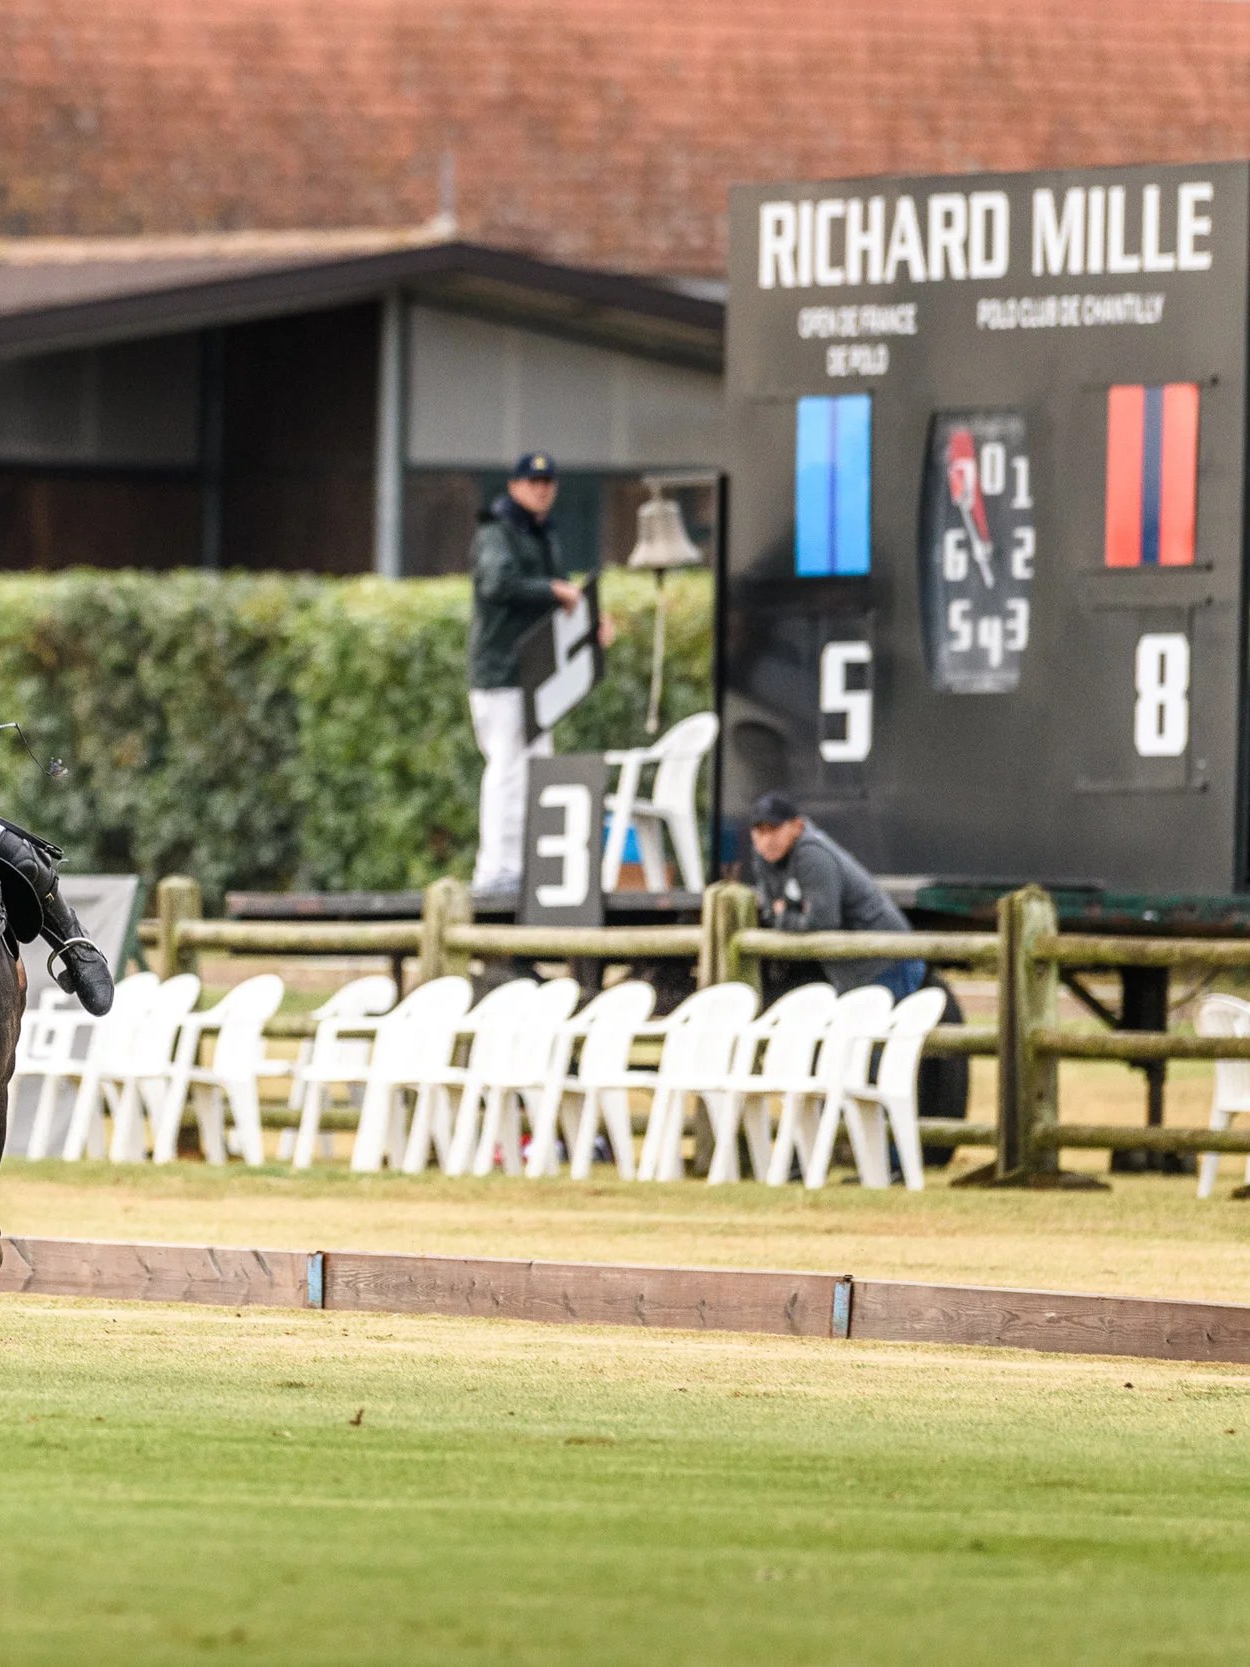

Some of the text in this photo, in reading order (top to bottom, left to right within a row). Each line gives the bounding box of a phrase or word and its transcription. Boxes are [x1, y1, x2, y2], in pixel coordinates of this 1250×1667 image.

[758, 182, 1214, 289] RICHARD MILLE
[819, 641, 873, 762] 5
[1135, 632, 1190, 757] 8
[535, 783, 591, 907] 3
